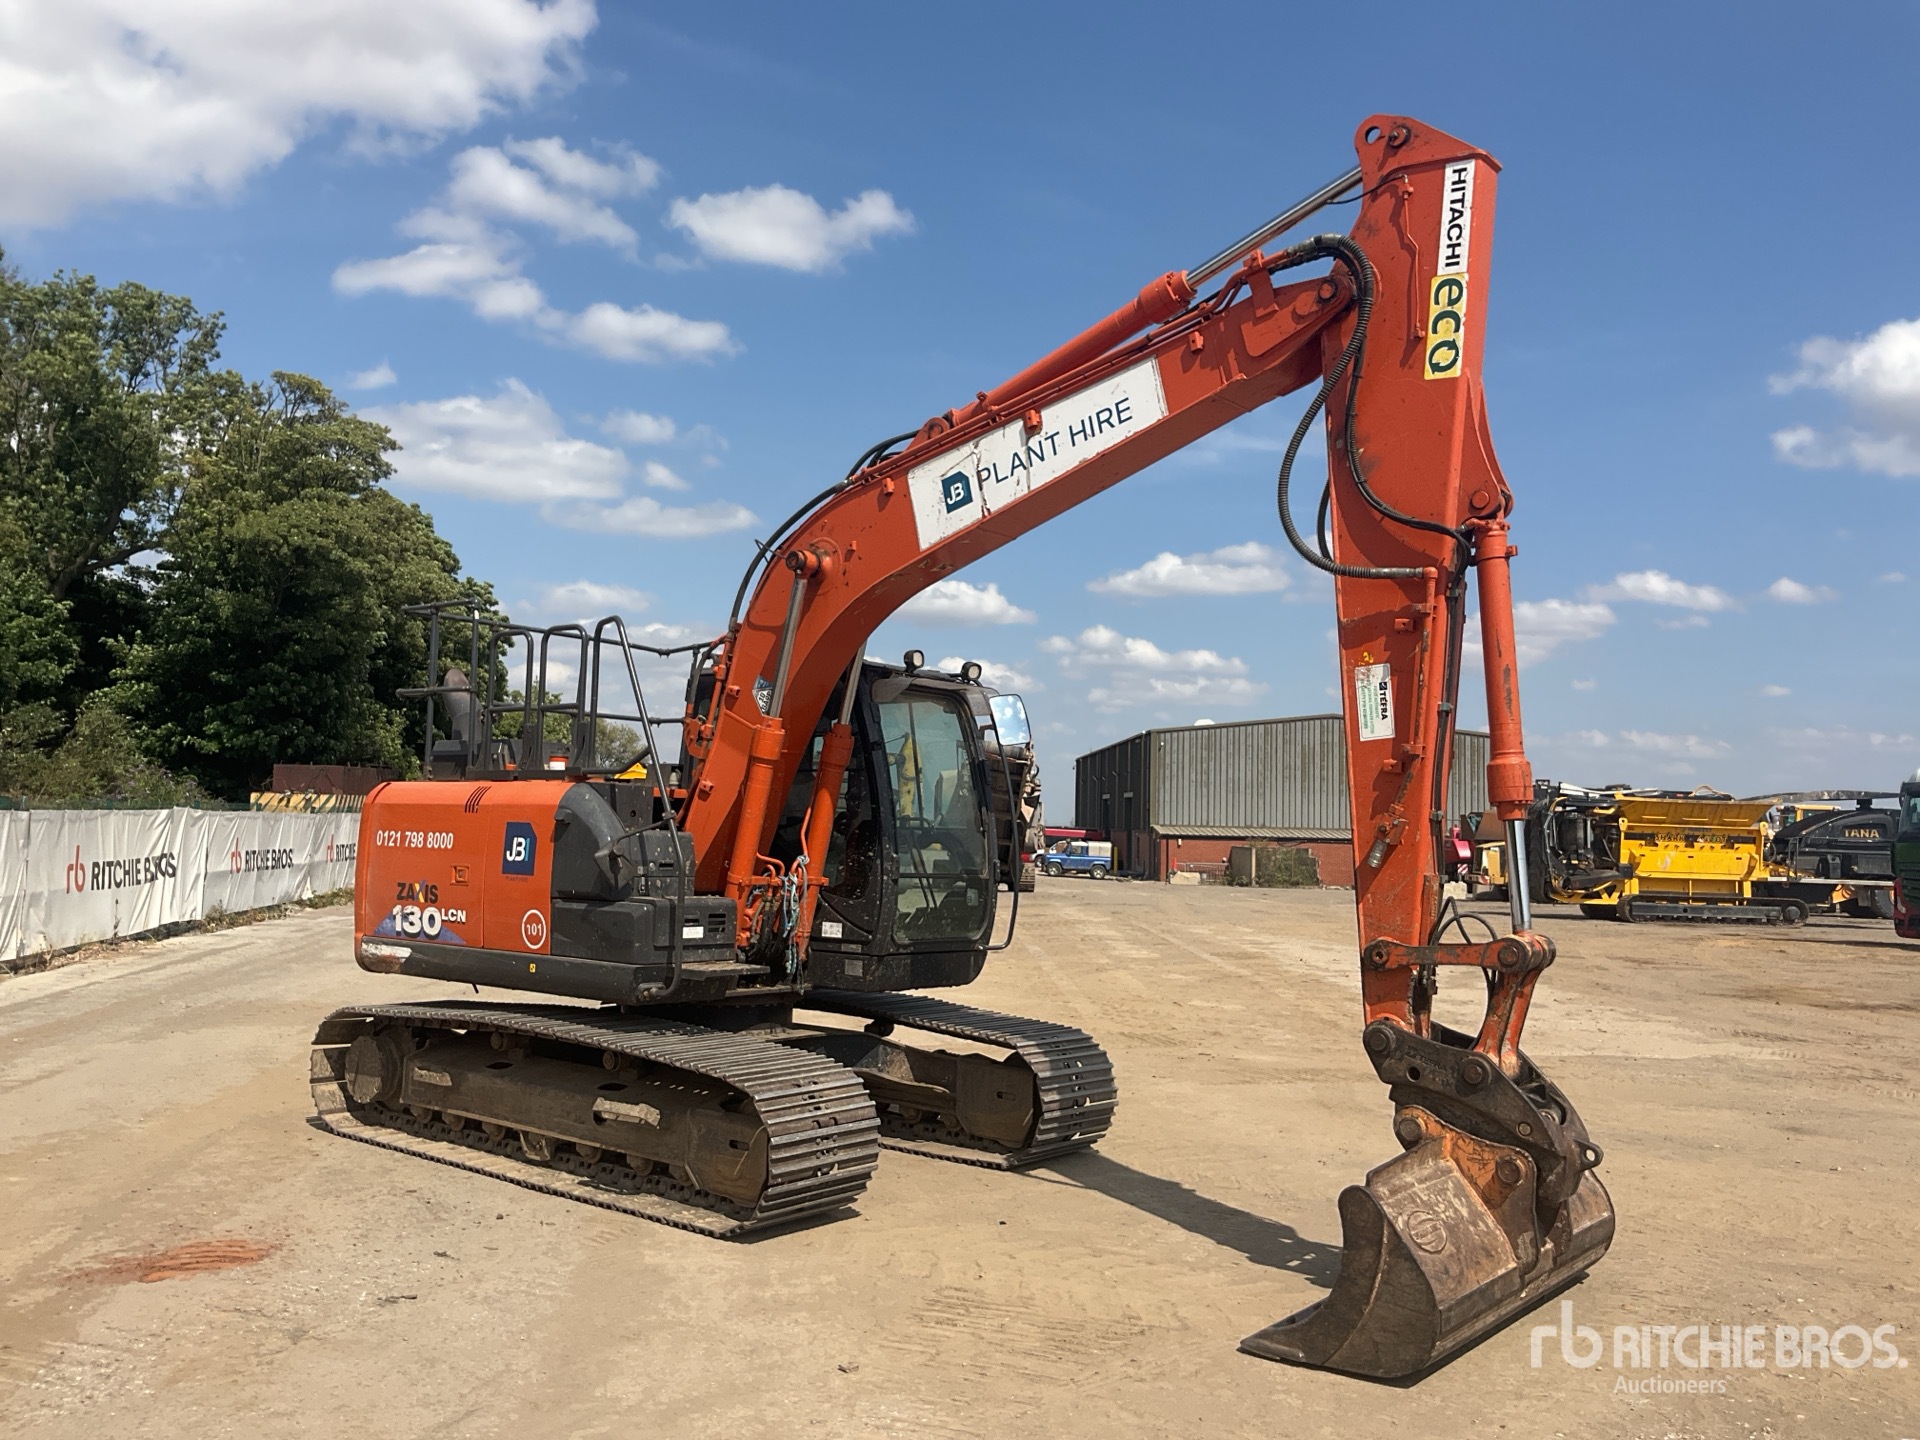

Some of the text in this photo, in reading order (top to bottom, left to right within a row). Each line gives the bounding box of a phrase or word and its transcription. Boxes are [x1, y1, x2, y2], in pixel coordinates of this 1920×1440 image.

[1445, 167, 1468, 268] HITACHI
[976, 431, 1060, 491] PLANT
[1068, 397, 1133, 447] HIRE
[376, 830, 454, 849] 0121 798 8000
[1843, 829, 1880, 838] TANA
[245, 849, 270, 872] RITCHIE
[91, 858, 142, 890] RITCHIE
[396, 880, 439, 904] ZAXIS
[392, 904, 467, 937] 130 LCN
[526, 923, 542, 936] 101
